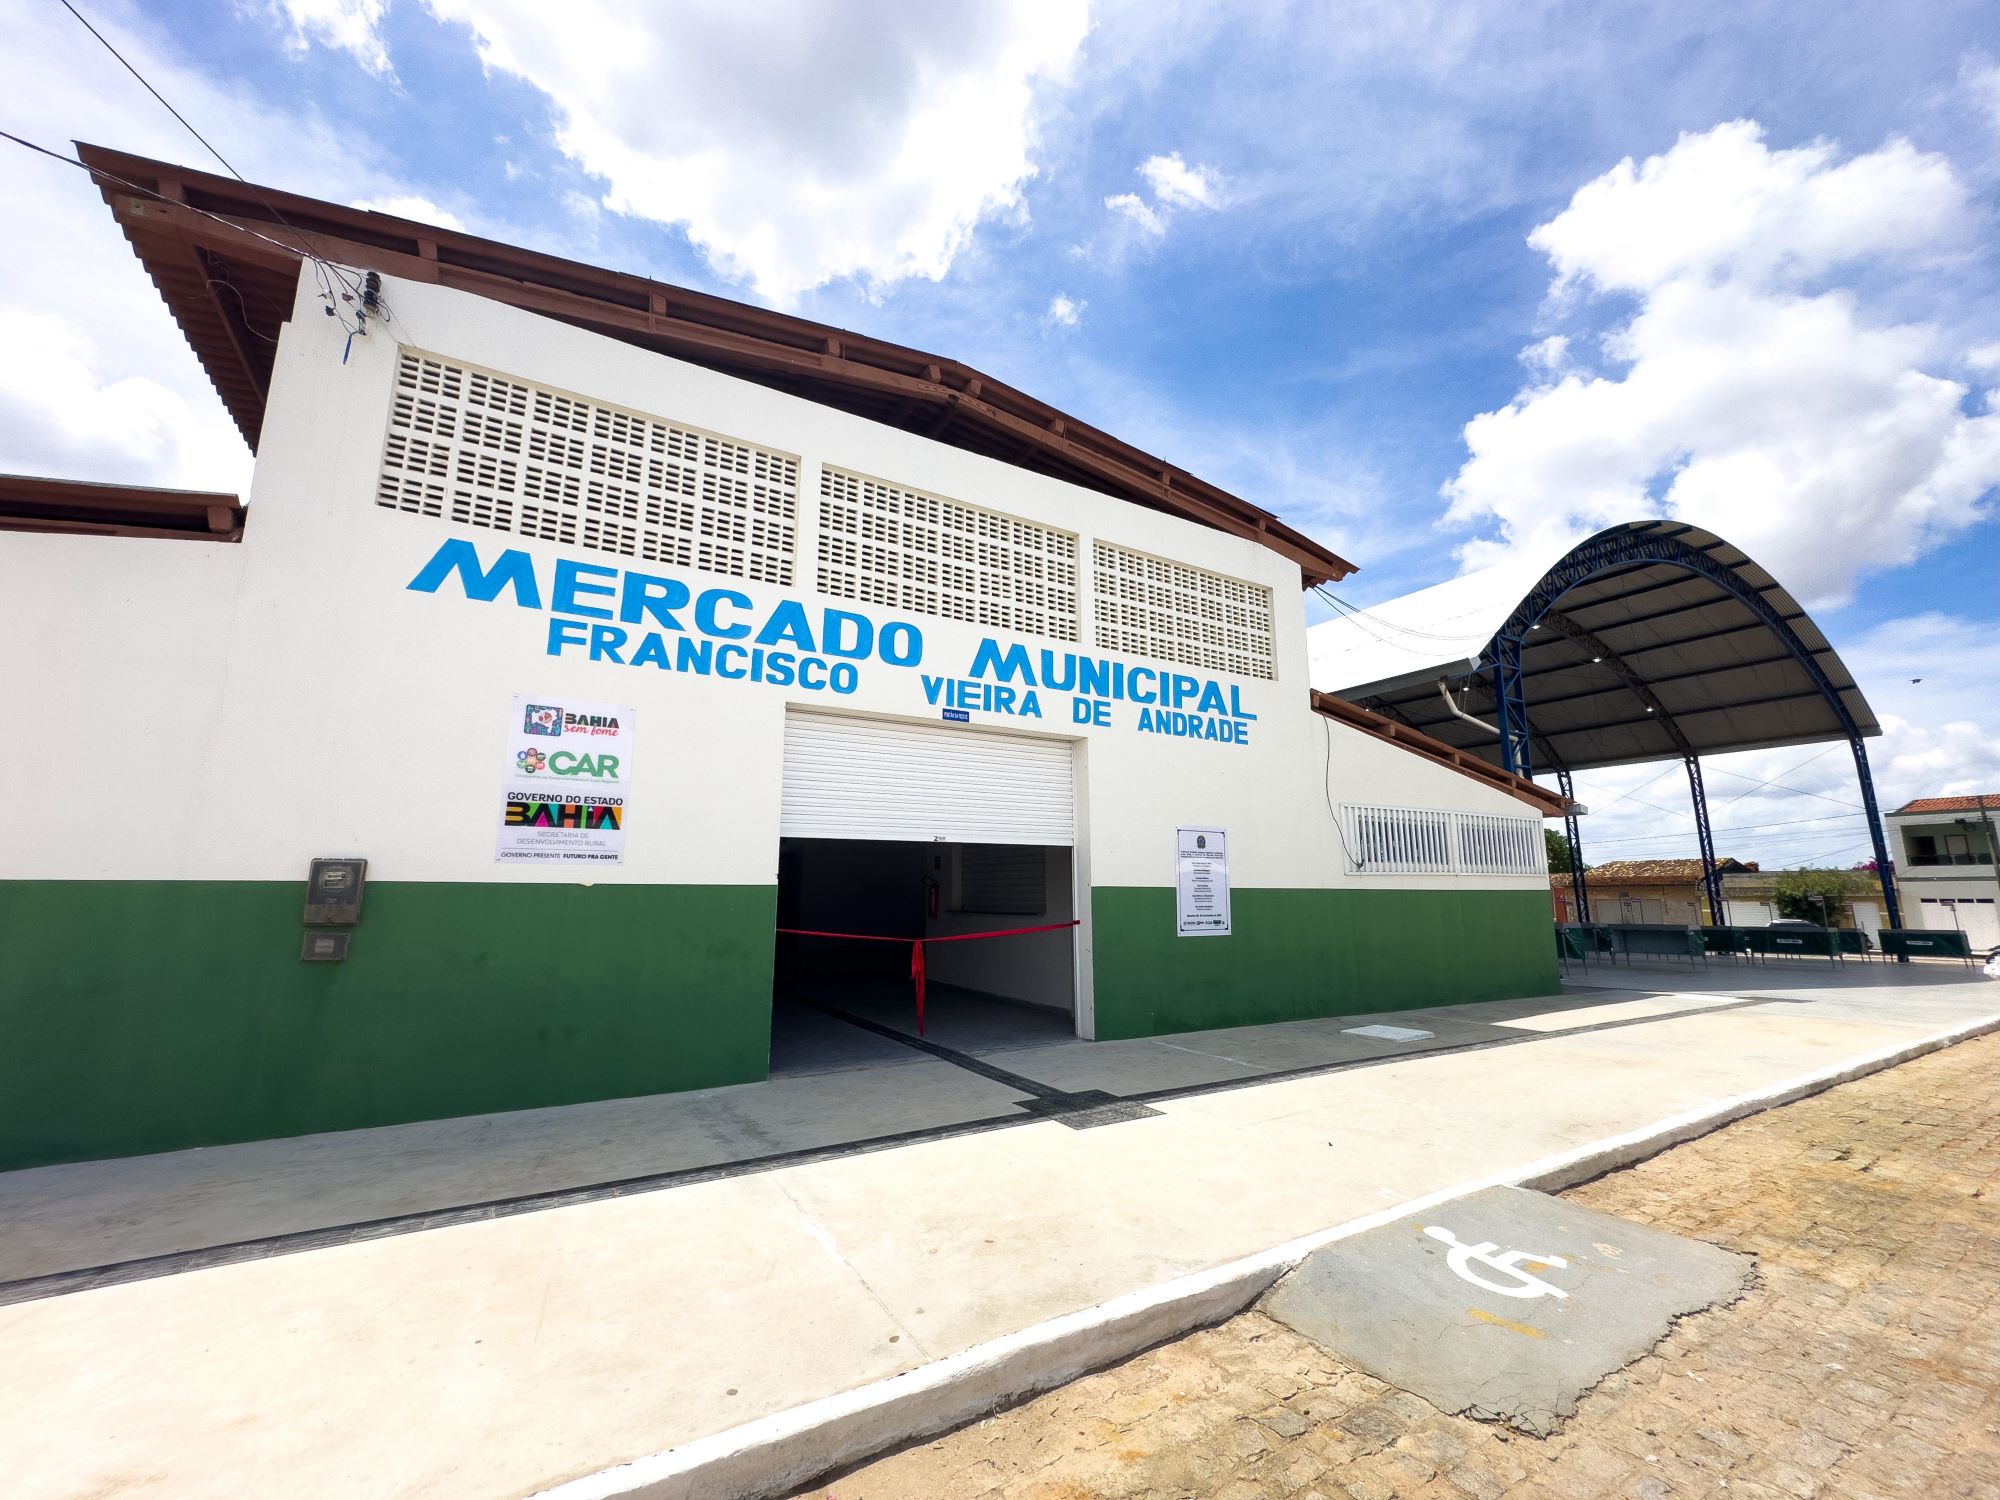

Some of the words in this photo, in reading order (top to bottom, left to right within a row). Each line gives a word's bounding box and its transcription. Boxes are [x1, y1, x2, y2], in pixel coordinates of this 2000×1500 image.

[406, 537, 923, 667] MERCADO
[968, 637, 1257, 721] MUNICIPAL
[546, 618, 858, 694] FRANCISCO
[921, 674, 1042, 718] VIEIRA
[1072, 697, 1111, 727] DE
[1138, 708, 1249, 745] ANDRADE
[564, 725, 588, 733] sem
[591, 726, 618, 736] fome
[565, 713, 619, 728] BAHIA
[549, 751, 619, 778] CAR
[508, 792, 562, 803] GOVERNO
[566, 795, 580, 803] DO
[584, 796, 623, 805] ESTADO
[505, 801, 622, 830] BAHIA
[517, 838, 583, 846] DESENVOLVIMENTO
